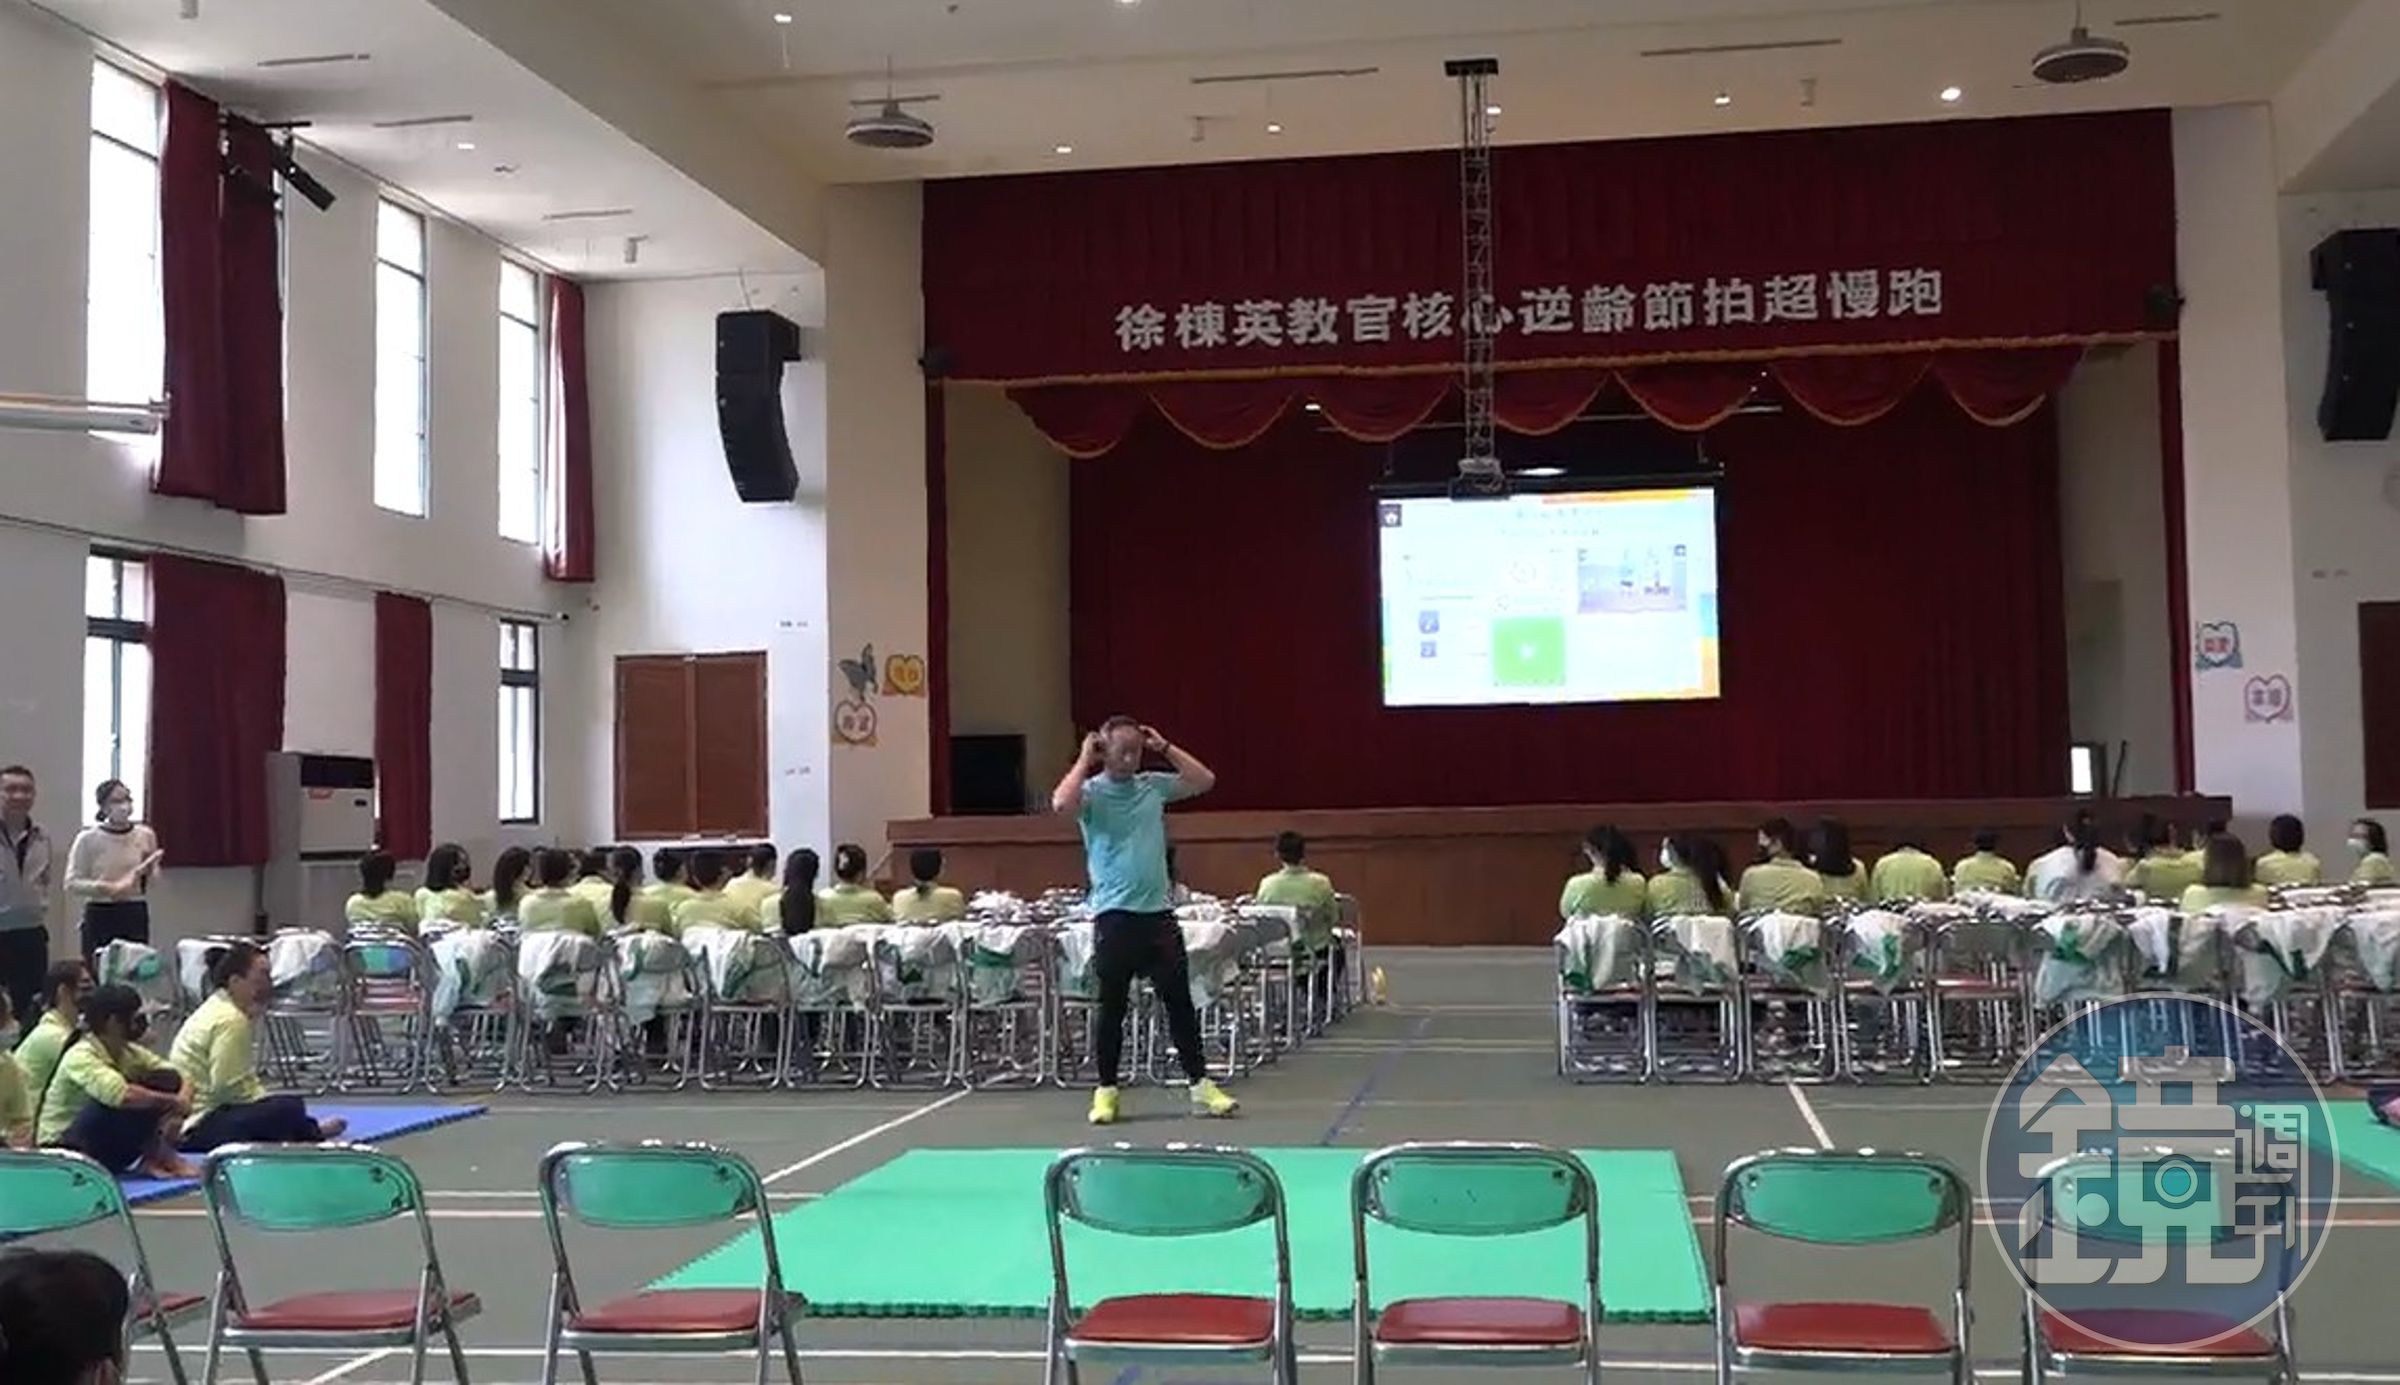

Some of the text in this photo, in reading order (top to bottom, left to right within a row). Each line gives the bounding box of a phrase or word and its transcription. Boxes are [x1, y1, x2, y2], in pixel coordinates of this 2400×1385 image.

[1115, 269, 1942, 353] 徐棟英教官核心逆齡節拍超慢跑
